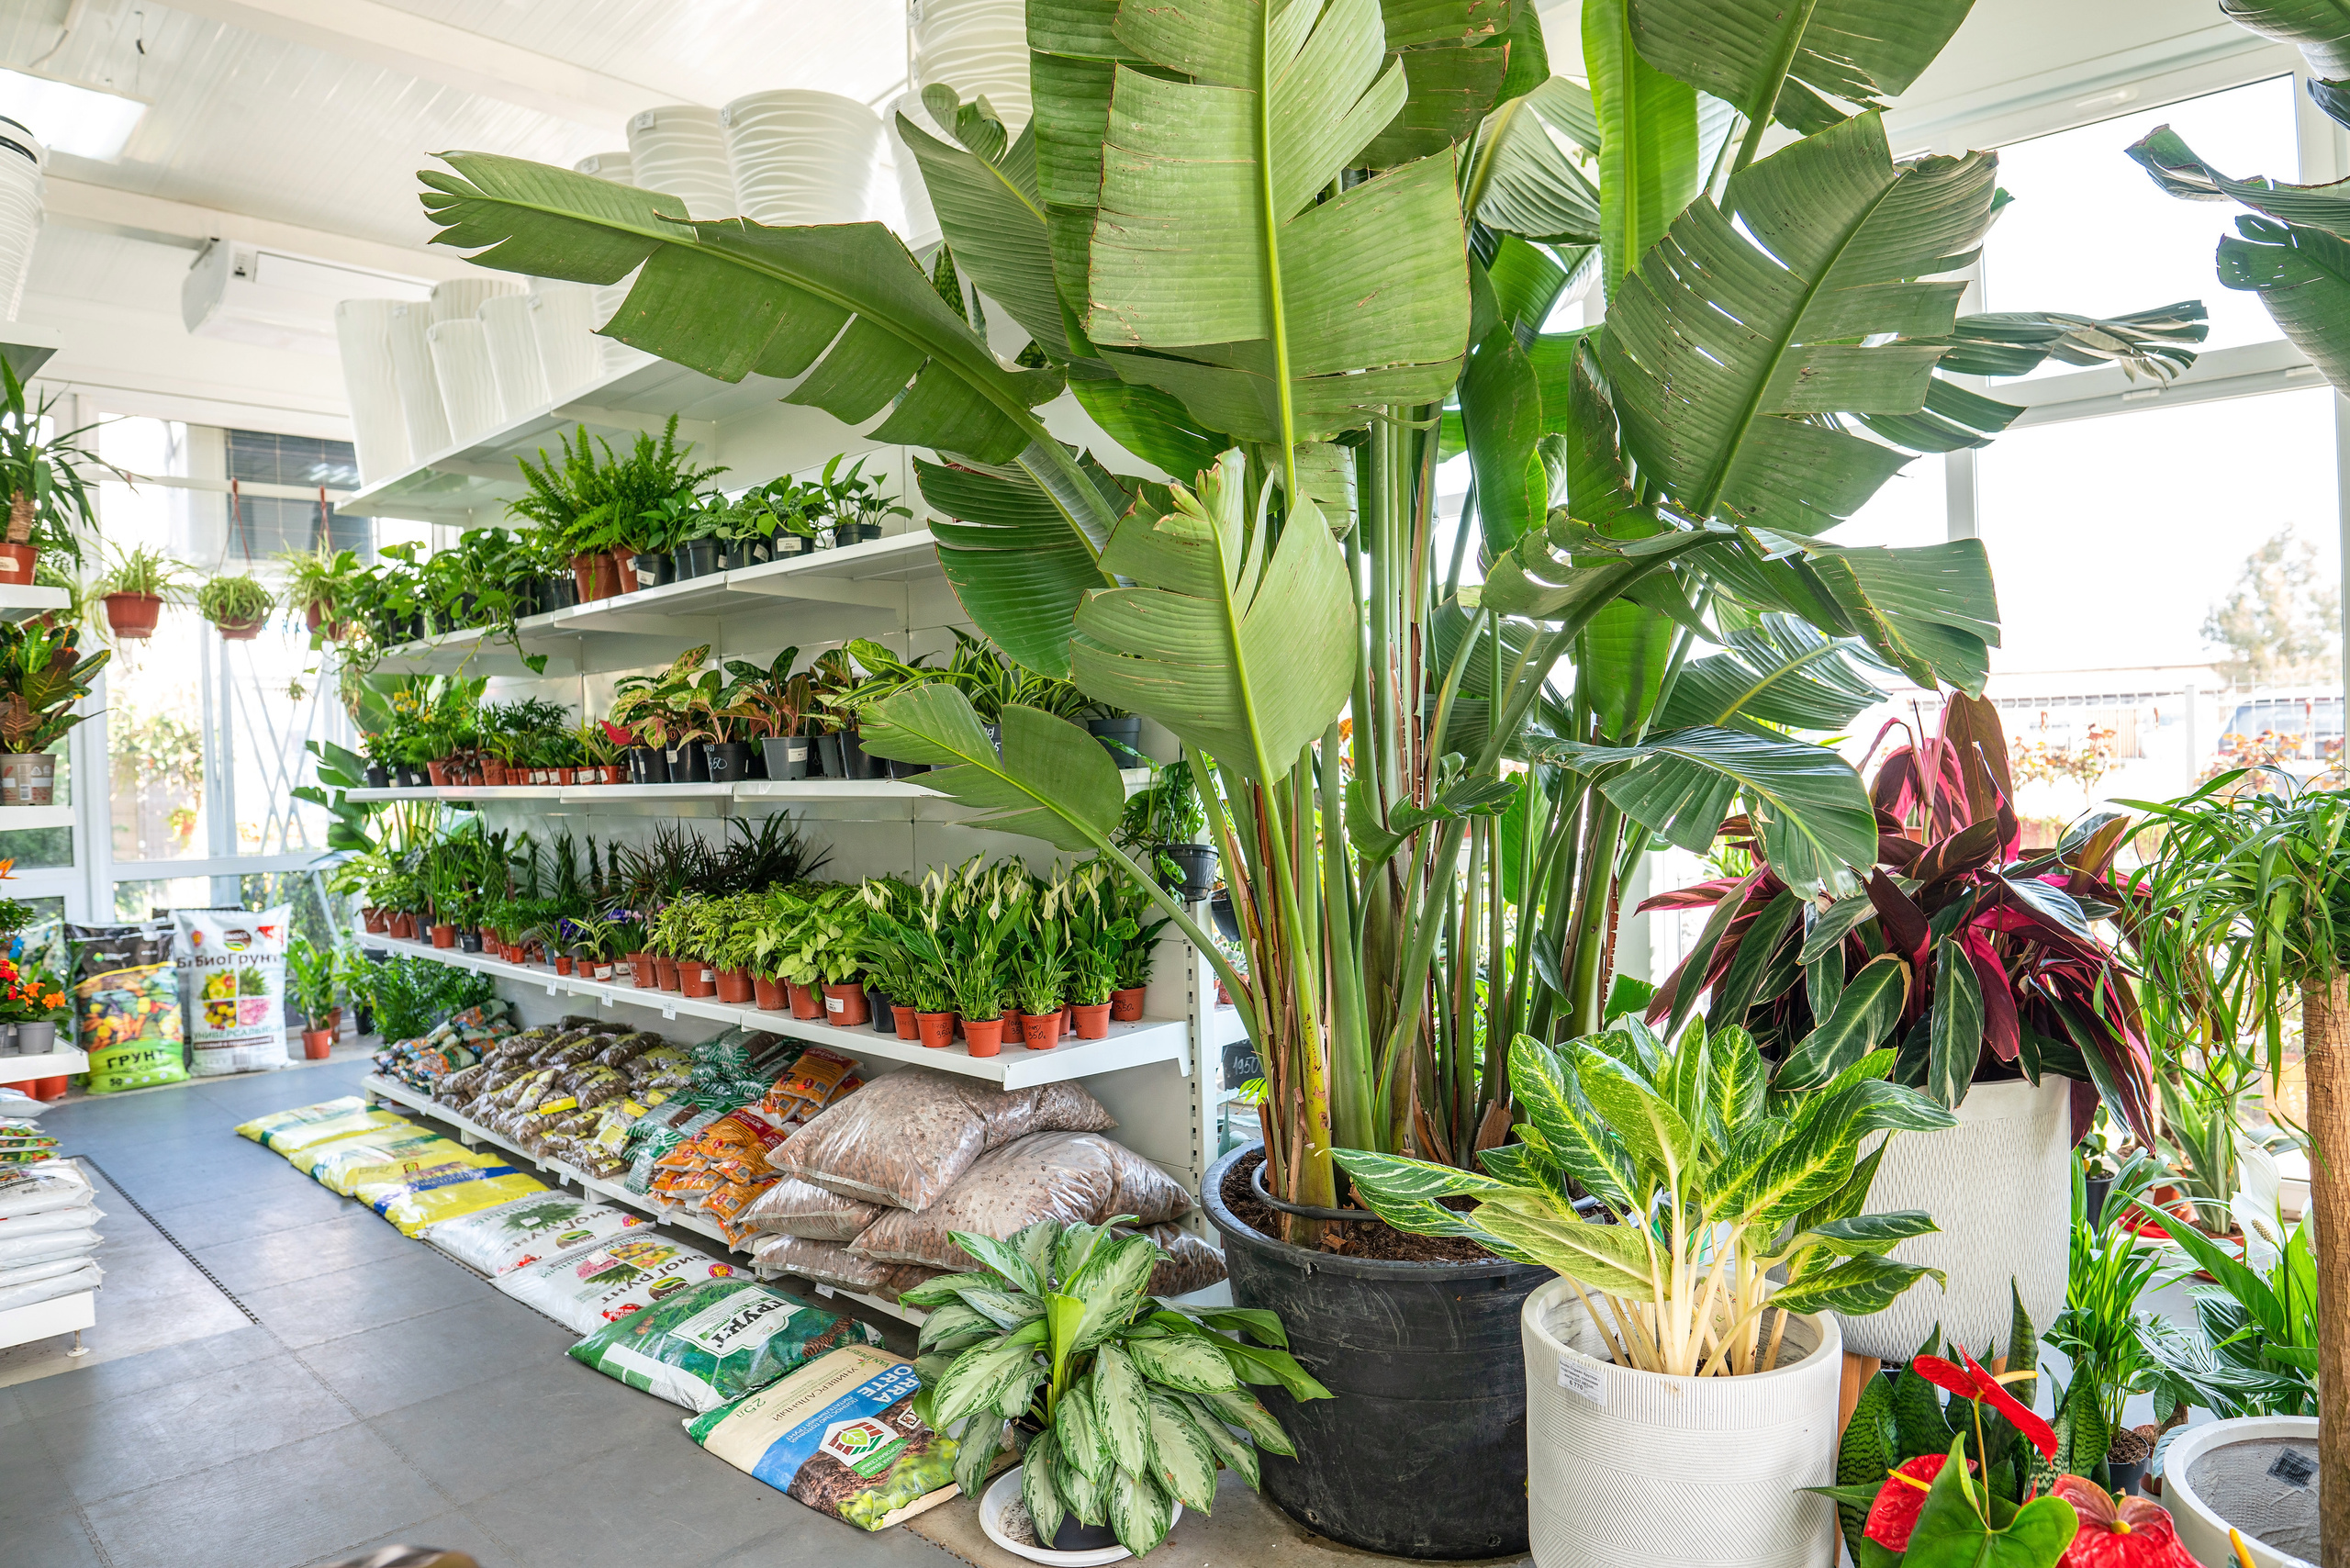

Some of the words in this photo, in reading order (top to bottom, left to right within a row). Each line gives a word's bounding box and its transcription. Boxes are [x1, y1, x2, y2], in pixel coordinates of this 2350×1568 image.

[196, 954, 277, 967] БиоГрунт
[106, 1049, 163, 1070] ГРУНТ
[1233, 1056, 1259, 1075] 1950
[601, 1255, 709, 1305] БиоГрунт
[711, 1301, 787, 1349] ГРУНТ
[856, 1365, 913, 1397] ORTE
[1574, 1382, 1583, 1390] 770
[773, 1366, 859, 1421] УНИВЕРСАЛЬНЫЙ
[736, 1397, 767, 1418] 25л
[806, 1395, 854, 1428] ПИТАТЕЛЬНЫЙ
[819, 1398, 858, 1424] ПОЛНОСТЬЮ
[786, 1424, 807, 1441] ГРУНТ
[789, 1422, 820, 1443] ГОТОВЫЙ
[860, 1458, 877, 1470] СЕМЬЯ
